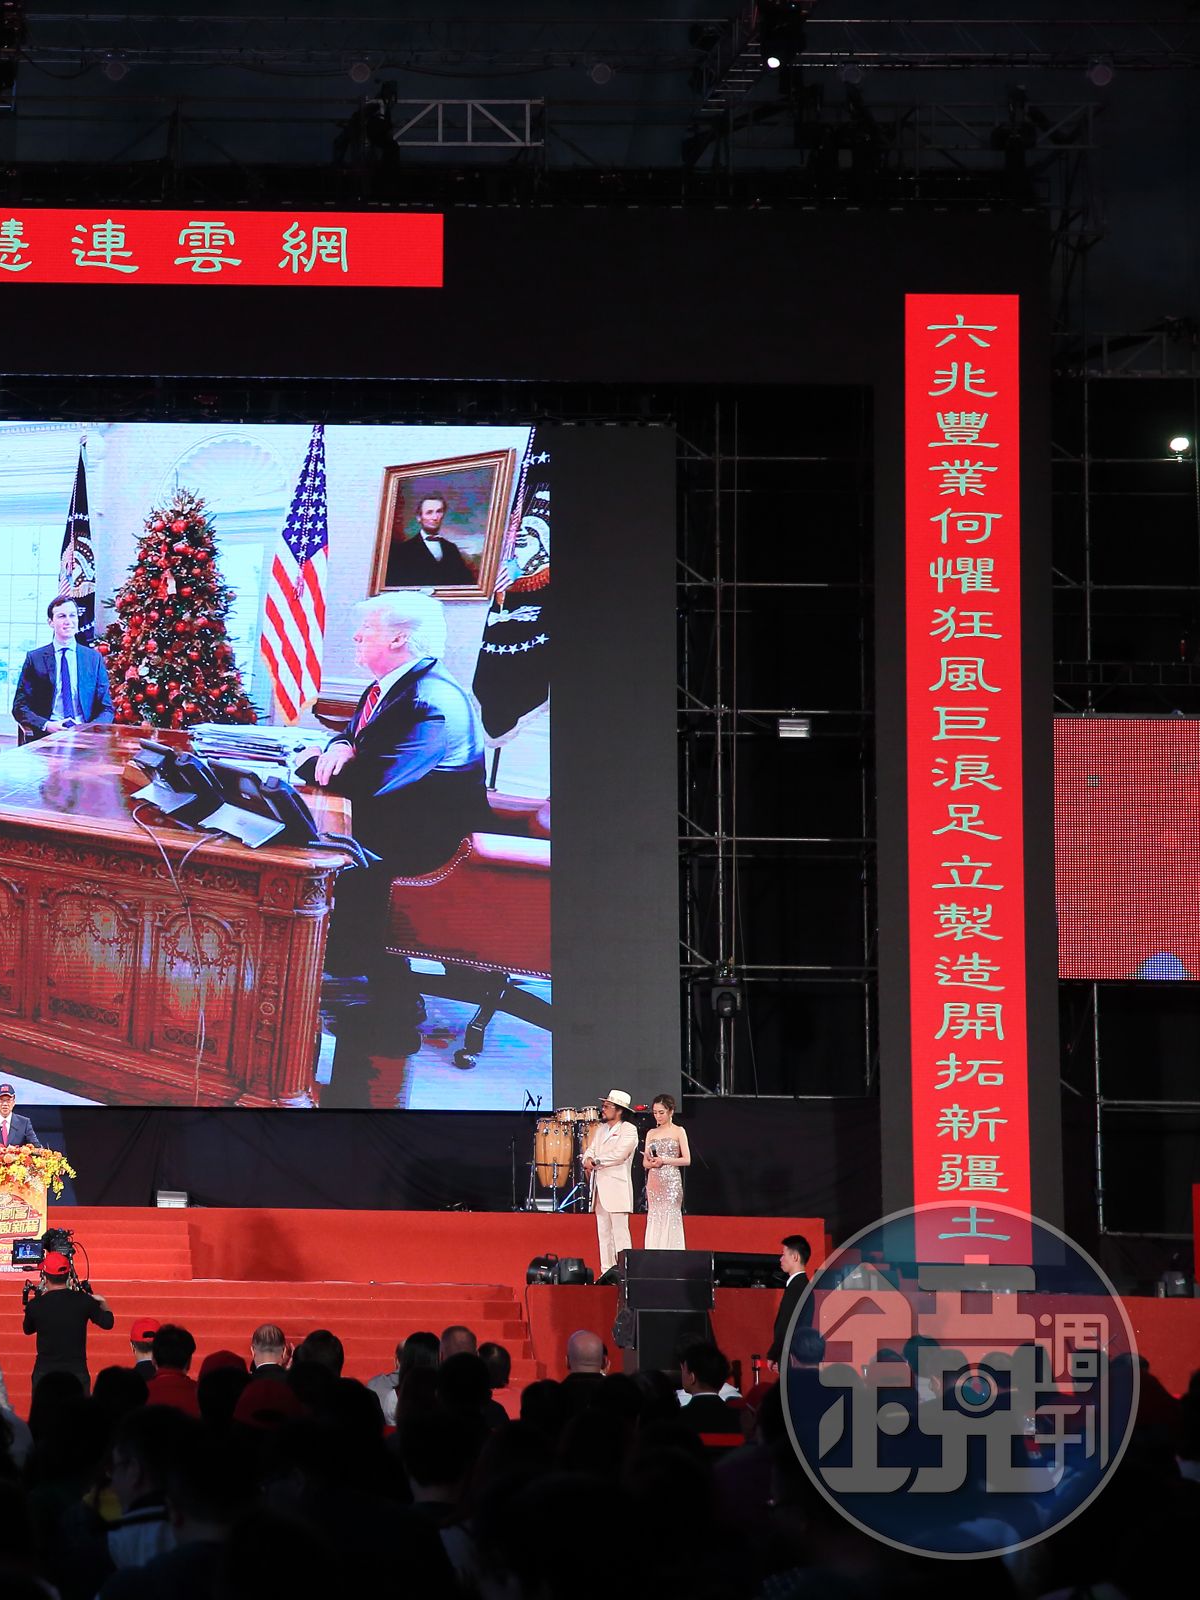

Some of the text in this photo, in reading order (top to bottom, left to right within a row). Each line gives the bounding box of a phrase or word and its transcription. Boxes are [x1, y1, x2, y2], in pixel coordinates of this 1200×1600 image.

[926, 314, 1011, 1241] 六兆豐業何懼狂風巨浪足立製造開拓新疆土
